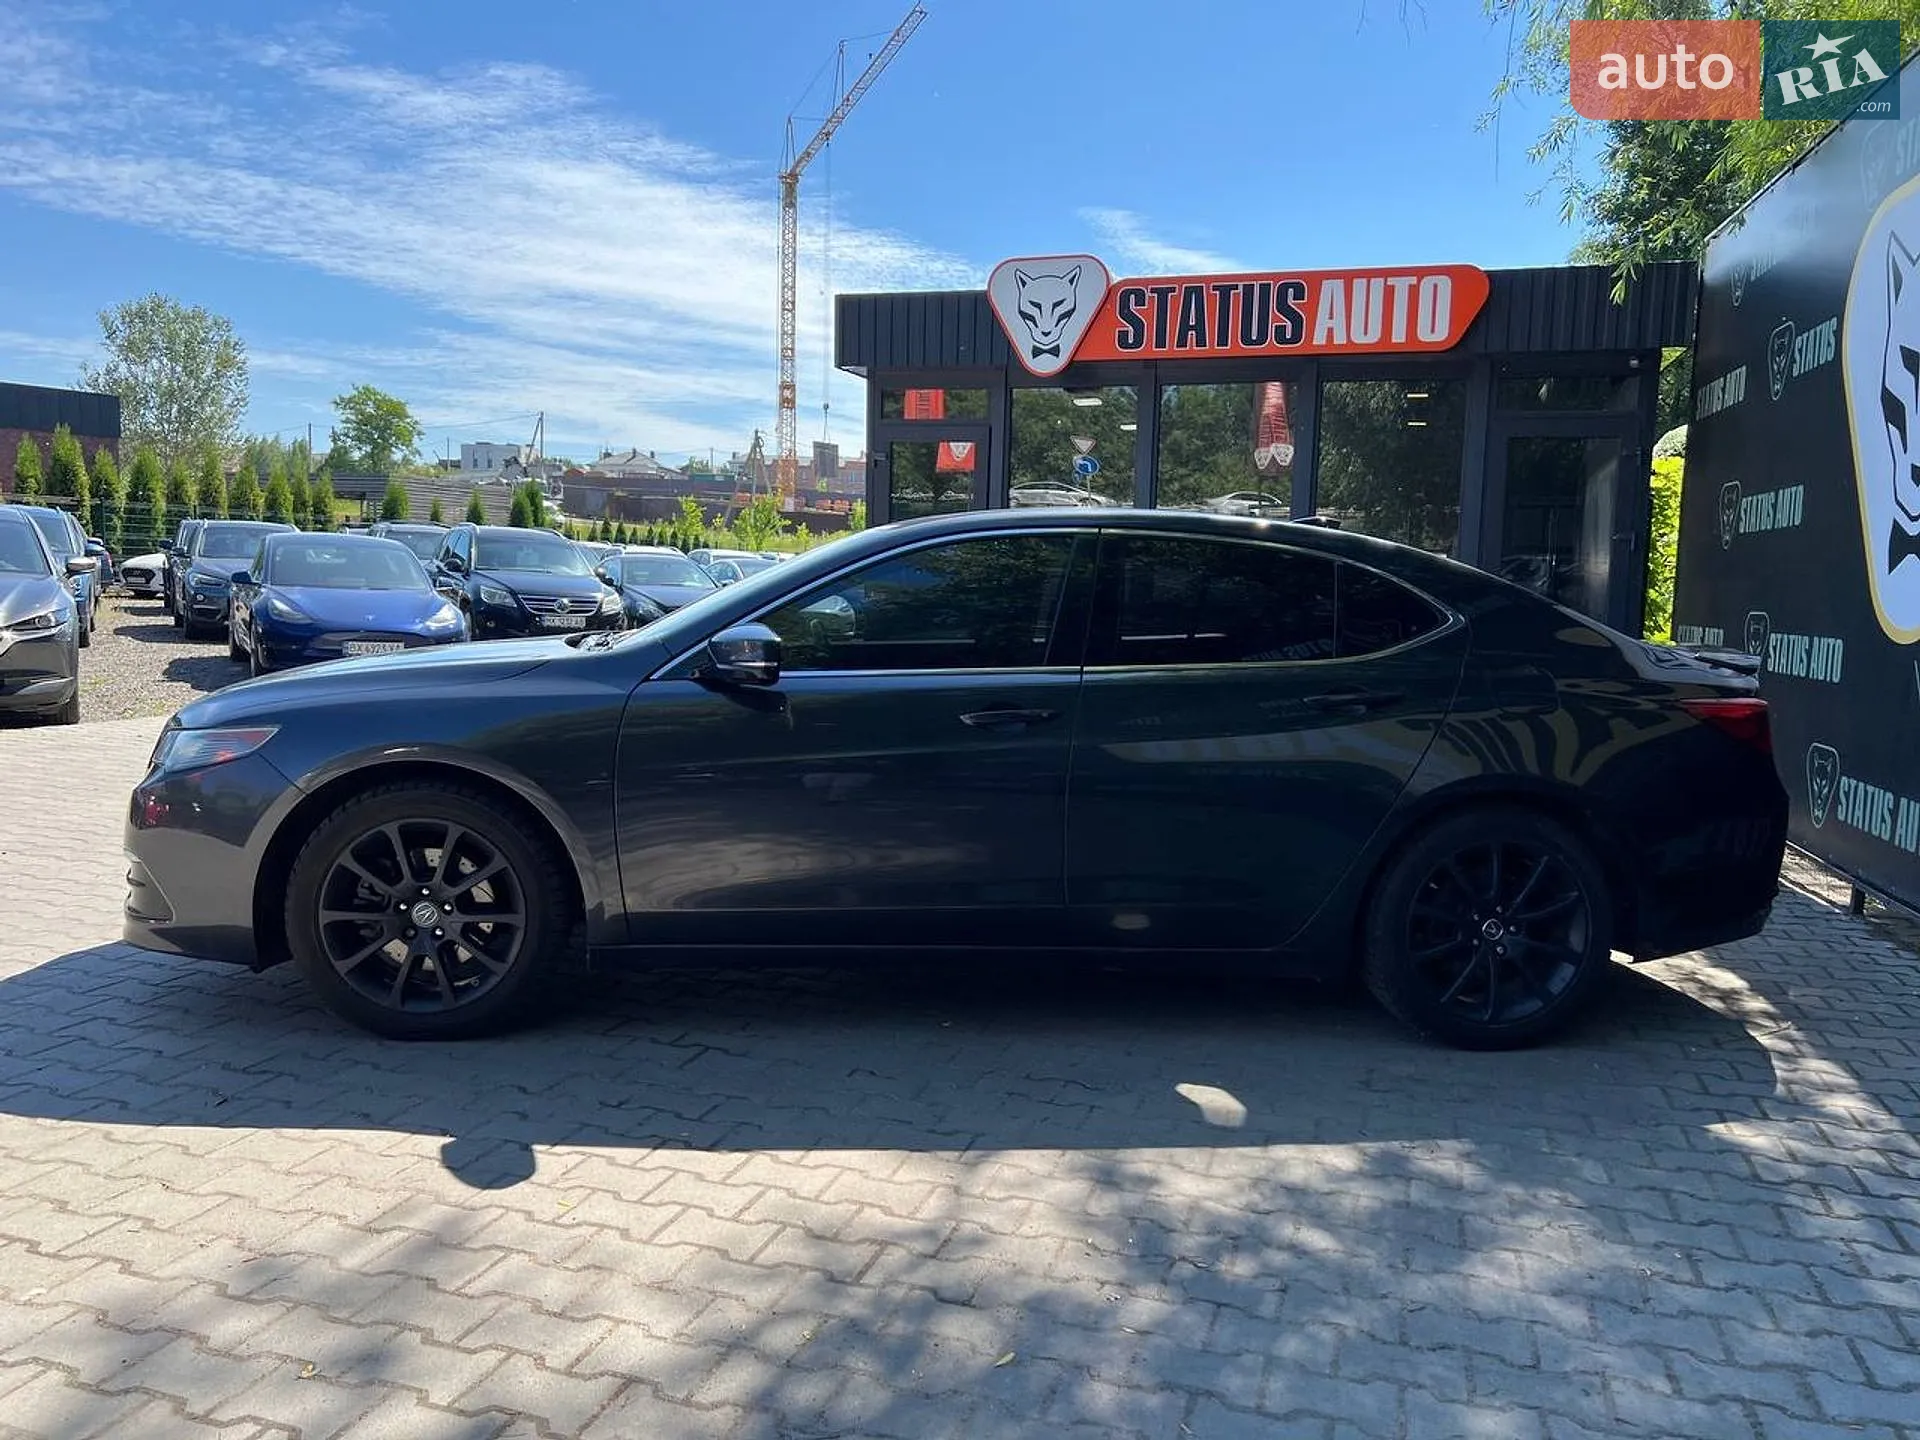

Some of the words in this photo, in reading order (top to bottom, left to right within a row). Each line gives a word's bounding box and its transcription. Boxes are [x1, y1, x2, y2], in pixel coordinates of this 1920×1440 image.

[1115, 280, 1307, 352] STATUS
[1312, 274, 1453, 346] AUTO
[1792, 316, 1838, 378] STATUS
[1724, 364, 1747, 409] AUTO
[1739, 492, 1775, 533] STATUS
[1775, 484, 1804, 529] AUTO
[1767, 633, 1809, 678] STATUS
[1809, 636, 1844, 683] AUTO
[1837, 775, 1894, 842] STATUS
[1894, 796, 1920, 856] AU
